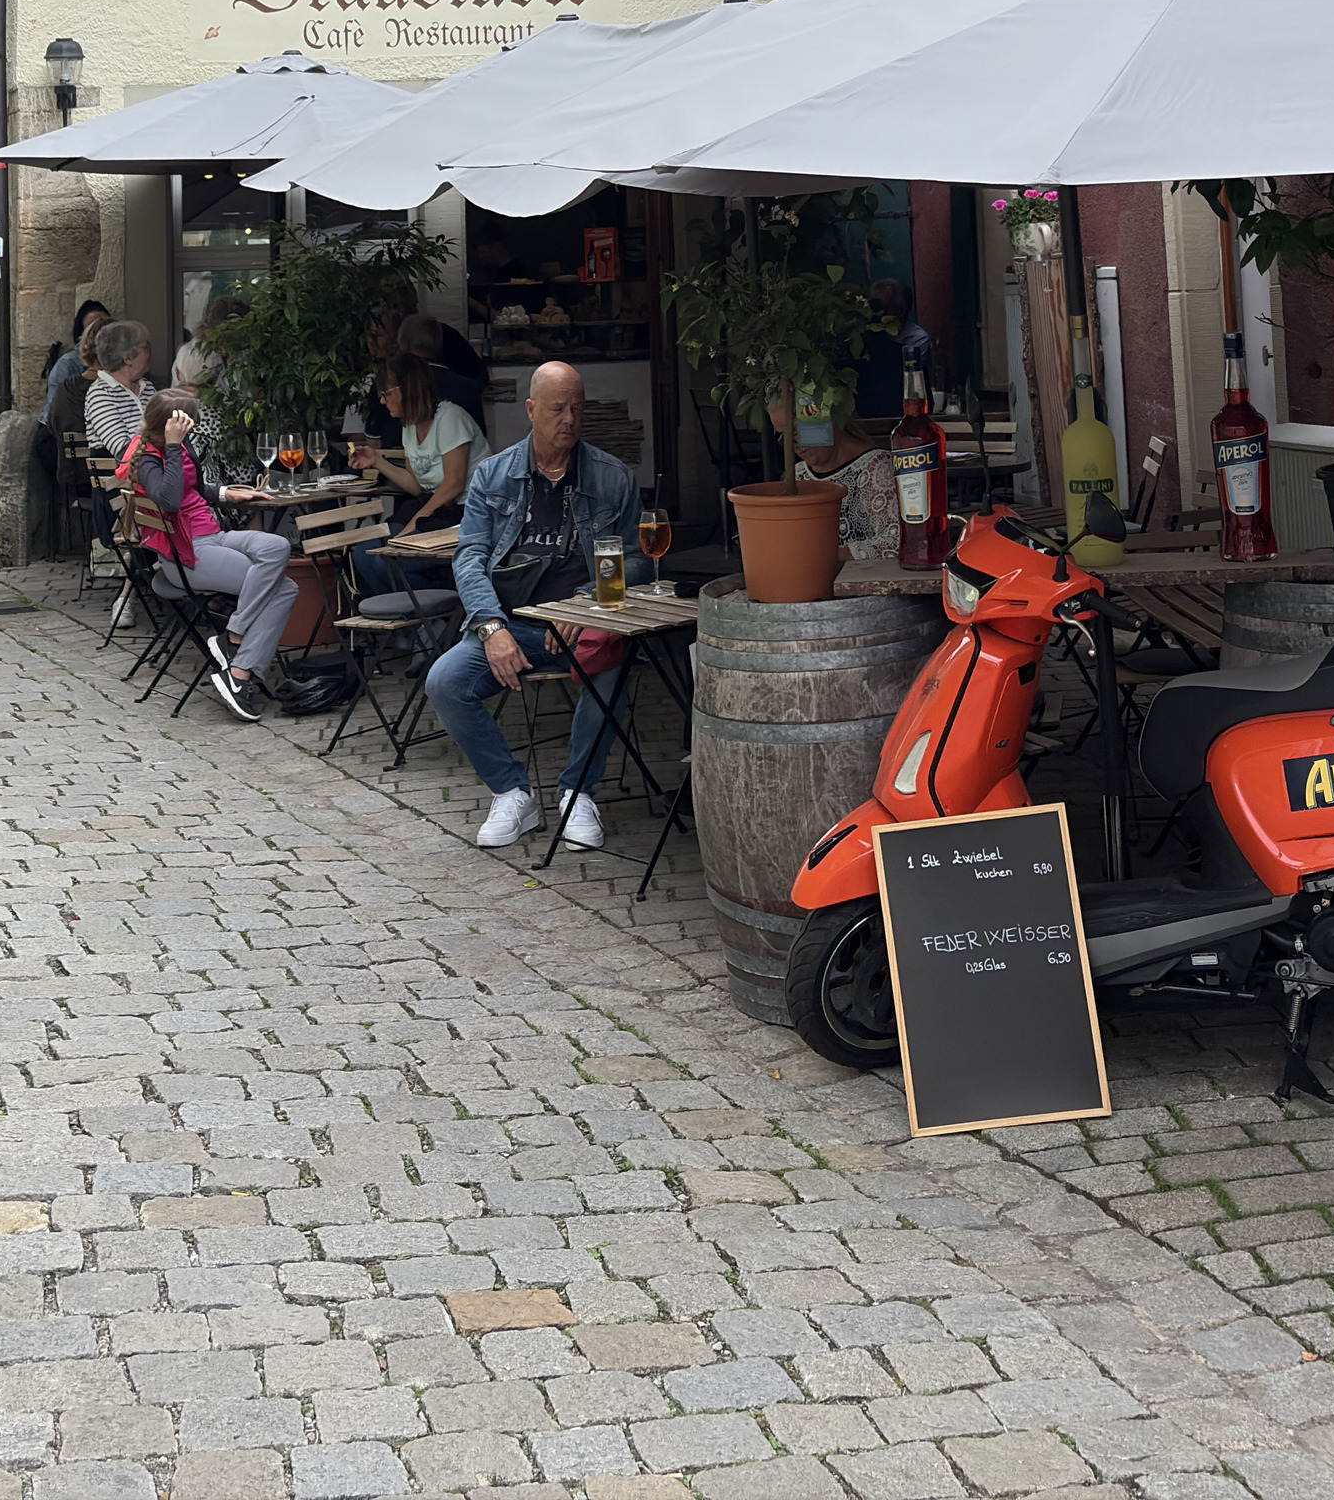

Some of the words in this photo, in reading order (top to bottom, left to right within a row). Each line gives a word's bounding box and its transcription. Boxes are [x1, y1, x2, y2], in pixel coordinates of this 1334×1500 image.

[385, 18, 535, 49] Restaurant
[893, 452, 933, 471] APEROL
[1218, 441, 1264, 463] APEROL
[1072, 481, 1111, 493] PALLINI
[907, 856, 914, 869] 1
[920, 853, 941, 868] Stk
[952, 846, 1004, 865] Zwiebel
[974, 867, 1013, 880] kuchen
[1033, 862, 1053, 876] 5,90
[921, 930, 982, 953] FEDER
[1047, 951, 1072, 965] 6,50
